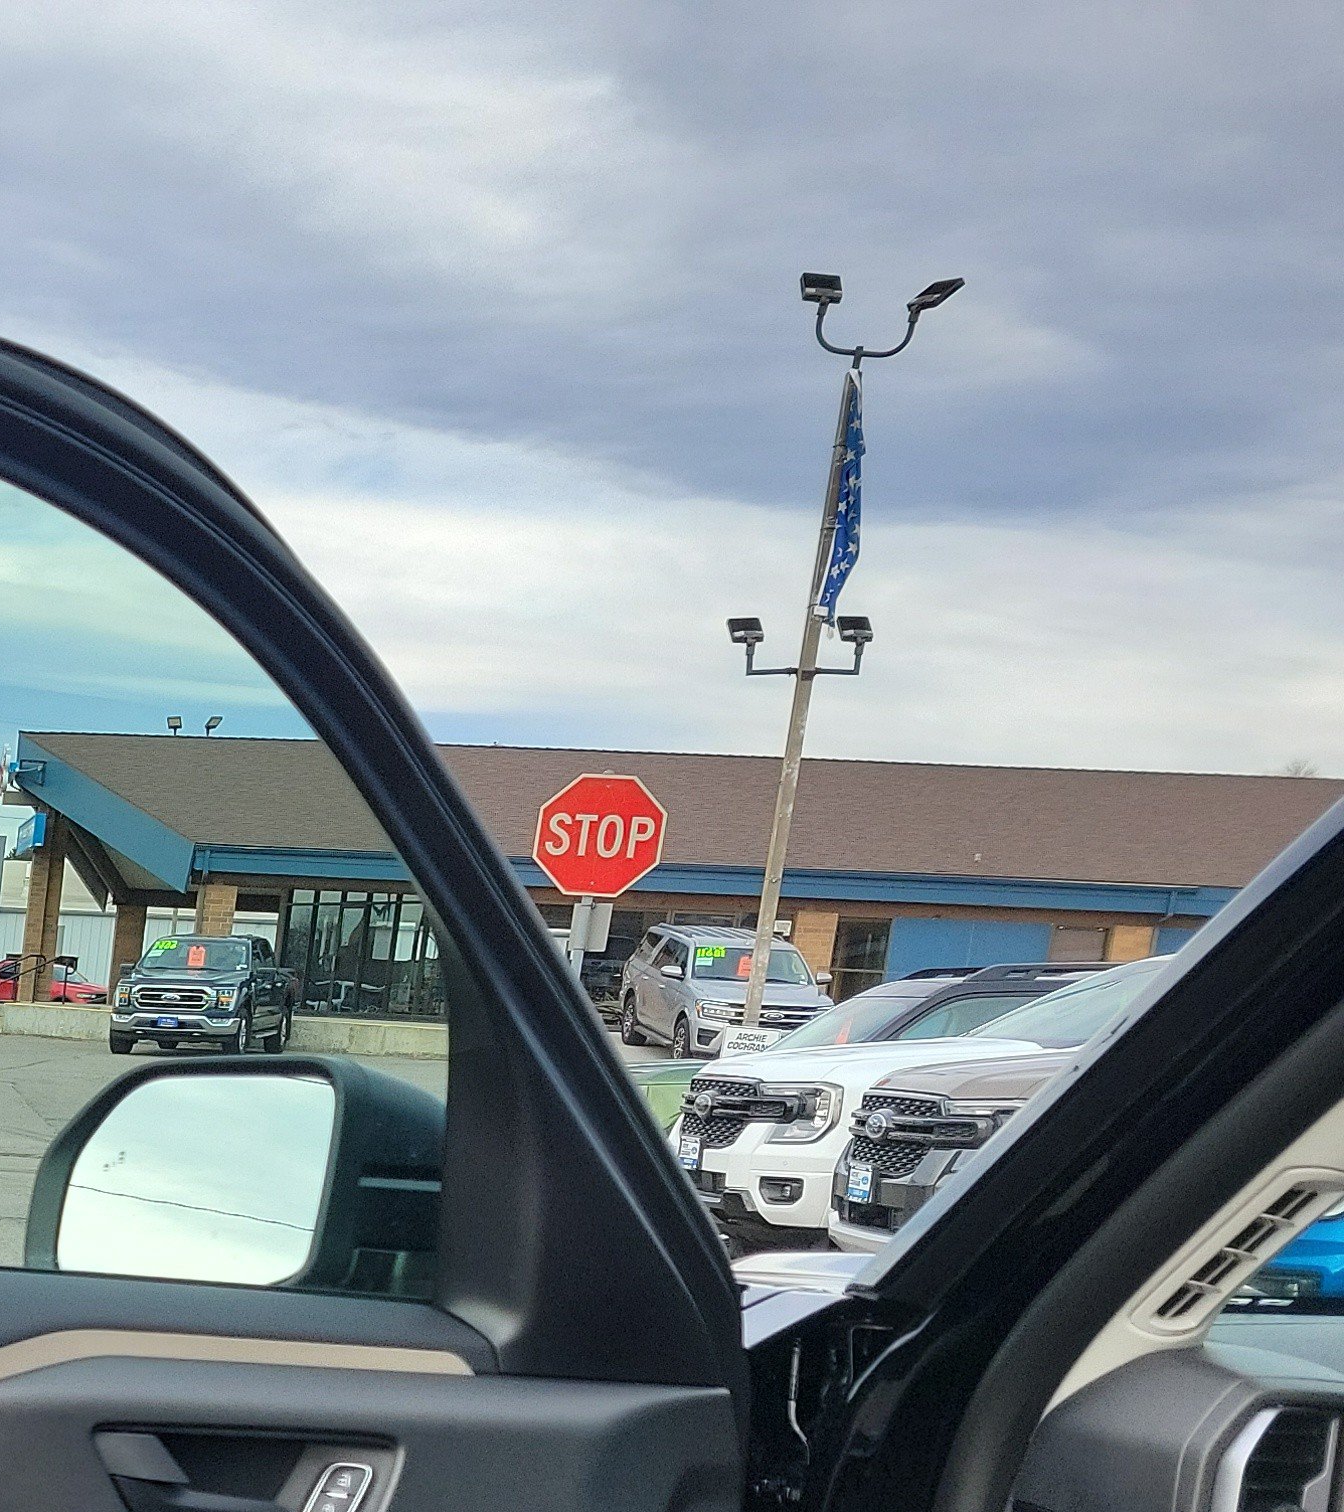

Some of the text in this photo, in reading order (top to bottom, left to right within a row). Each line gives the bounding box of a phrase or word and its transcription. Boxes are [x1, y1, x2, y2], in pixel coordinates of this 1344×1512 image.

[544, 812, 656, 860] STOP
[736, 1032, 768, 1043] ARCHIE
[726, 1042, 770, 1053] COCHRAN
